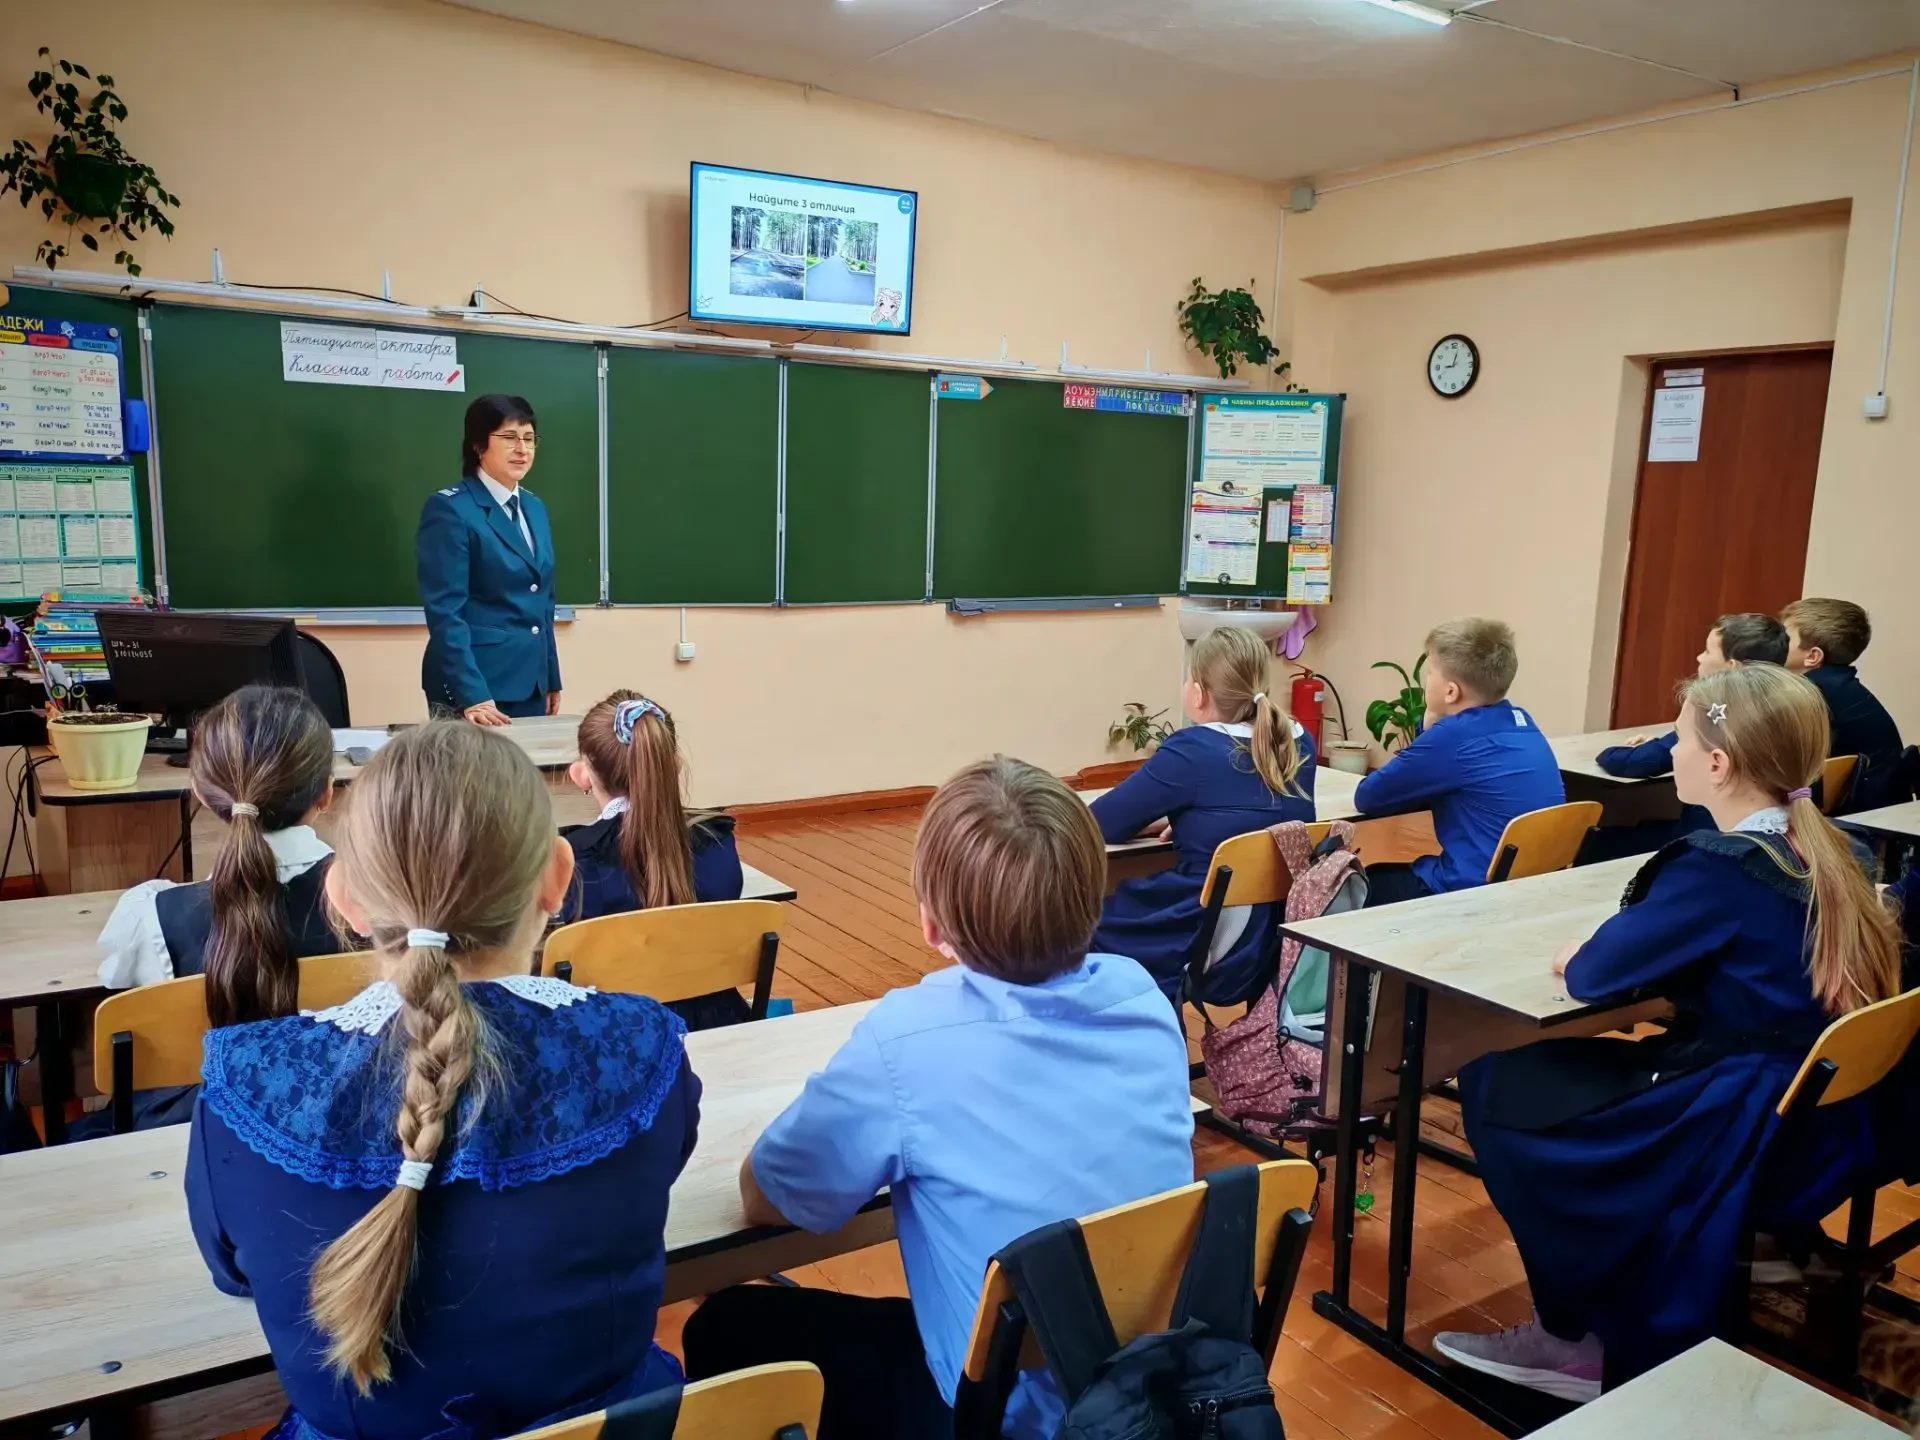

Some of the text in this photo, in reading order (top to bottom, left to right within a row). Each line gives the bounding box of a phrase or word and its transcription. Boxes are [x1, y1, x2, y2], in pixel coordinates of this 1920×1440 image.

[749, 192, 855, 214] Найдите 3 отличия
[0, 316, 44, 332] АДЕЖИ
[282, 329, 454, 362] Пятнадцатое октября
[288, 354, 445, 384] Классная работа
